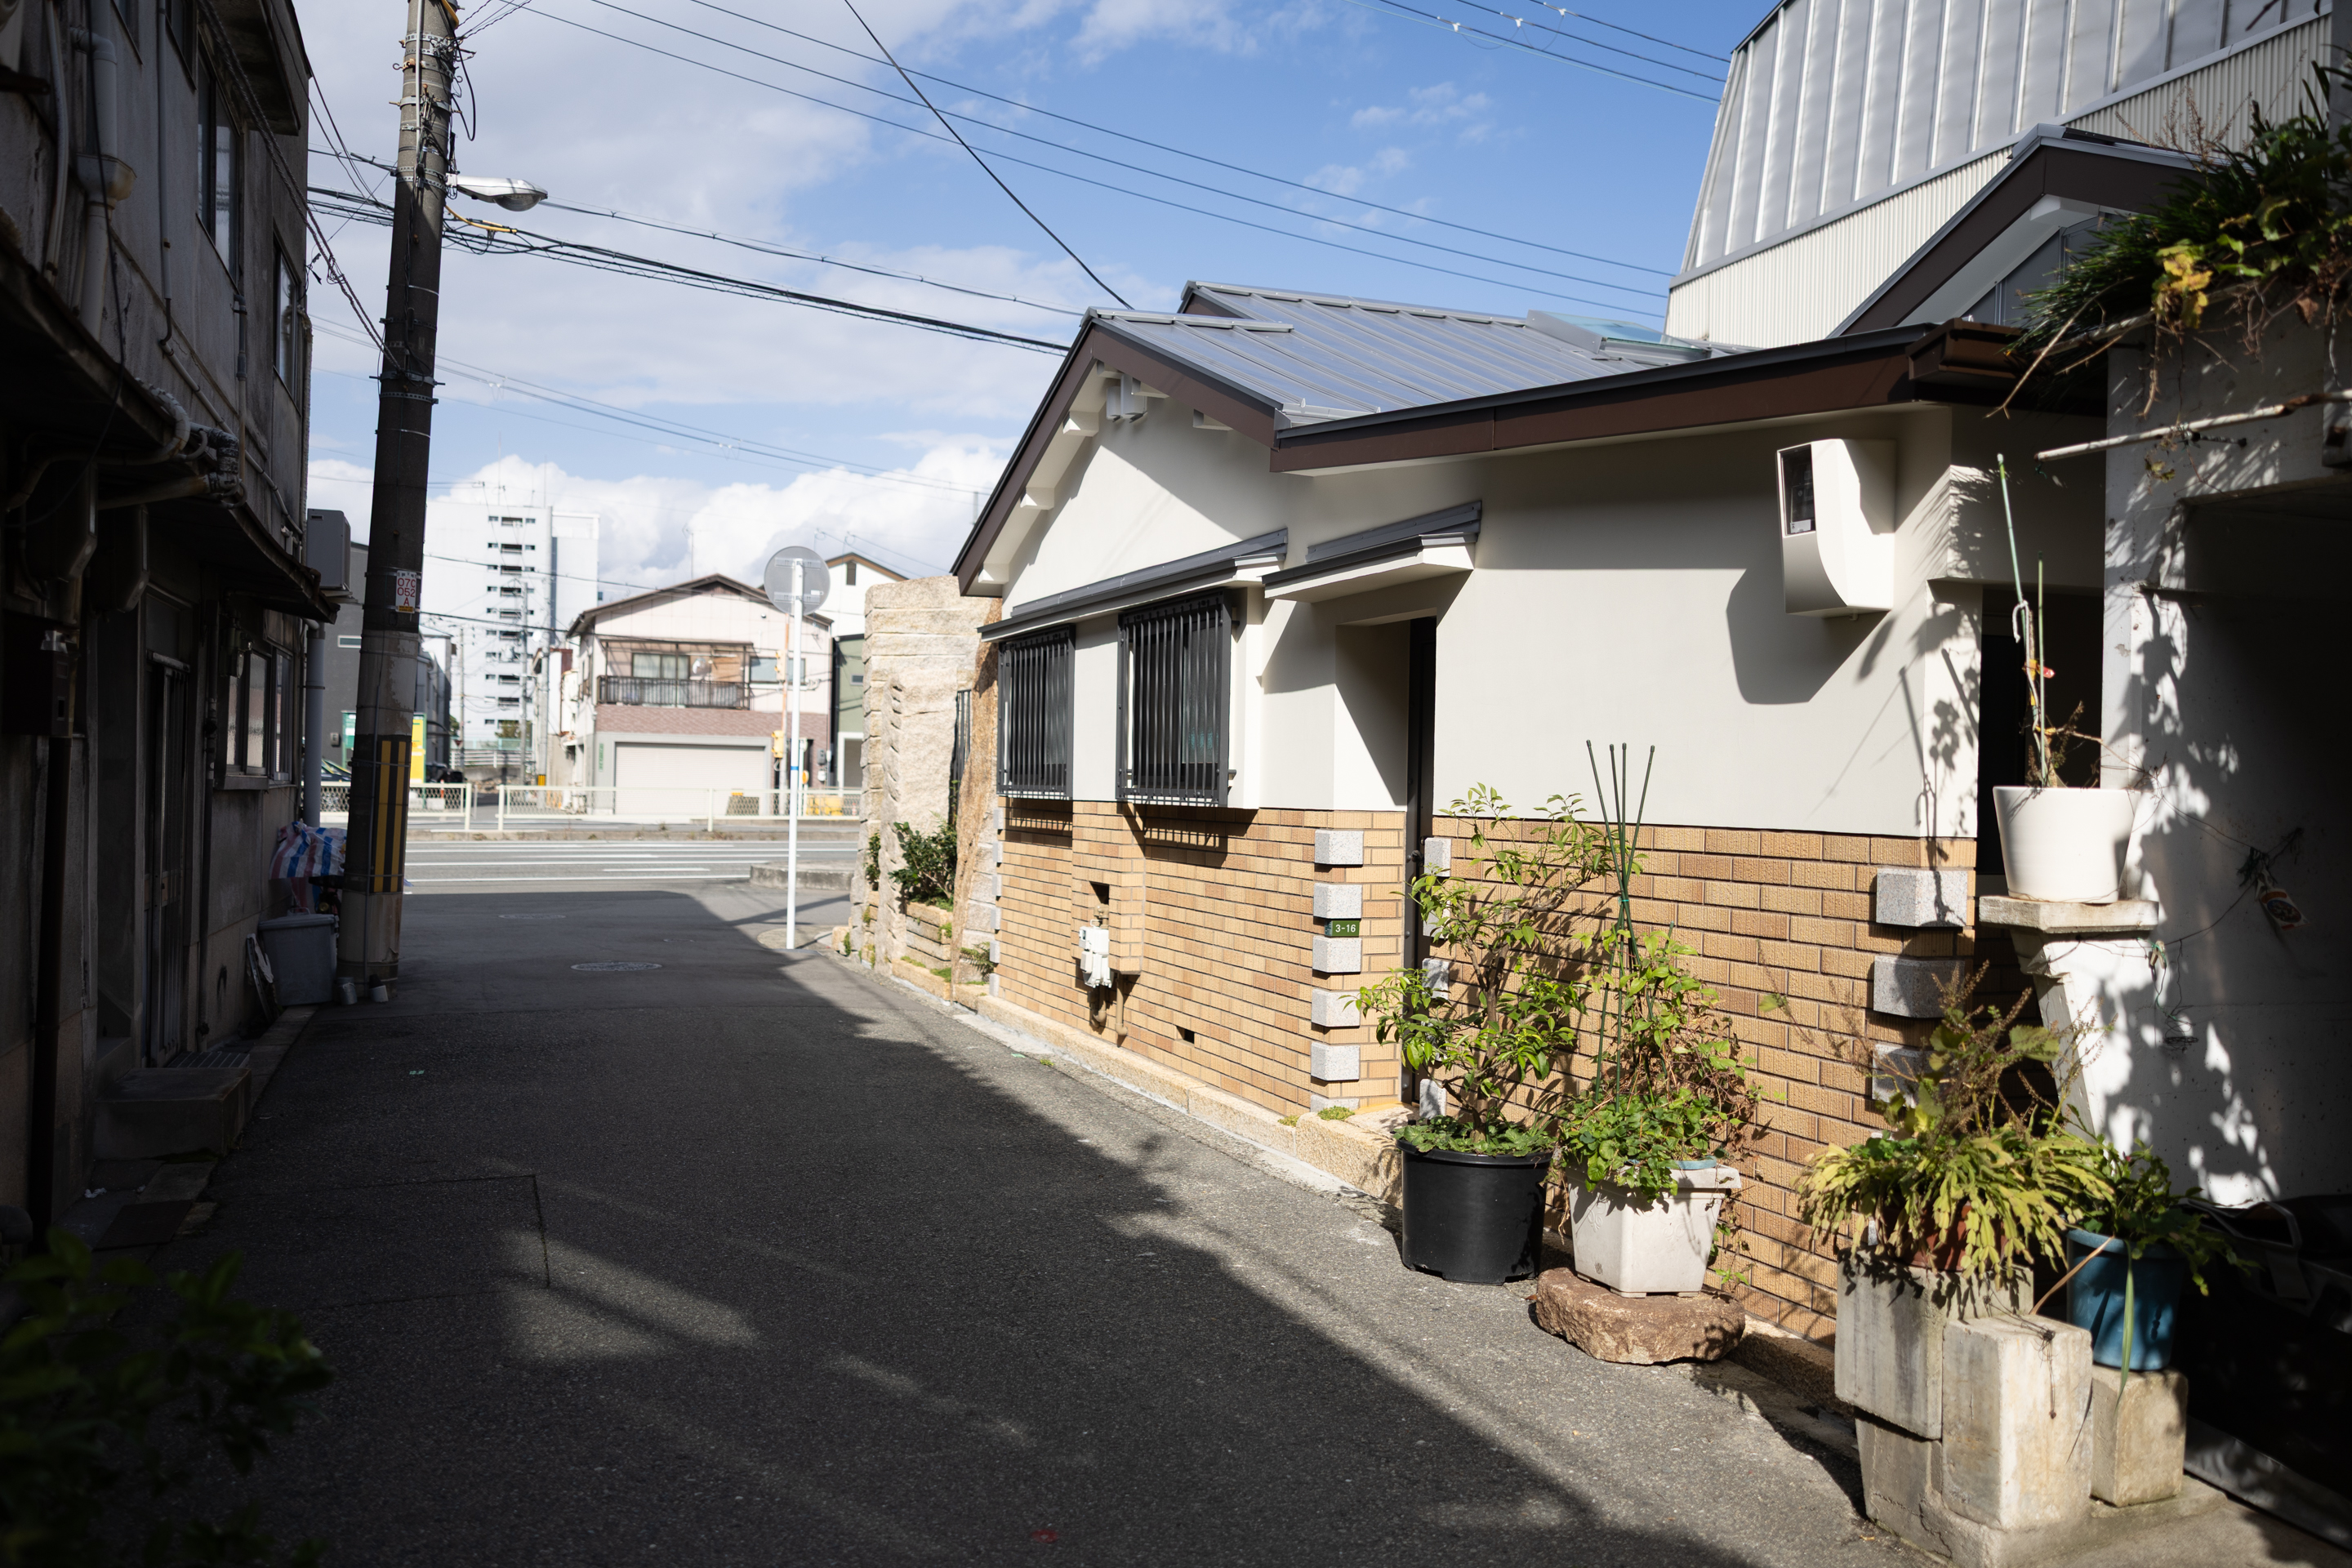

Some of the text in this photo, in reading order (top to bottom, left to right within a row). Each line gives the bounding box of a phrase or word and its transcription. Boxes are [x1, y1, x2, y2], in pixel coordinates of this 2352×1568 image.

[397, 587, 416, 598] 052
[403, 597, 410, 606] A
[1335, 924, 1356, 933] 3-16
